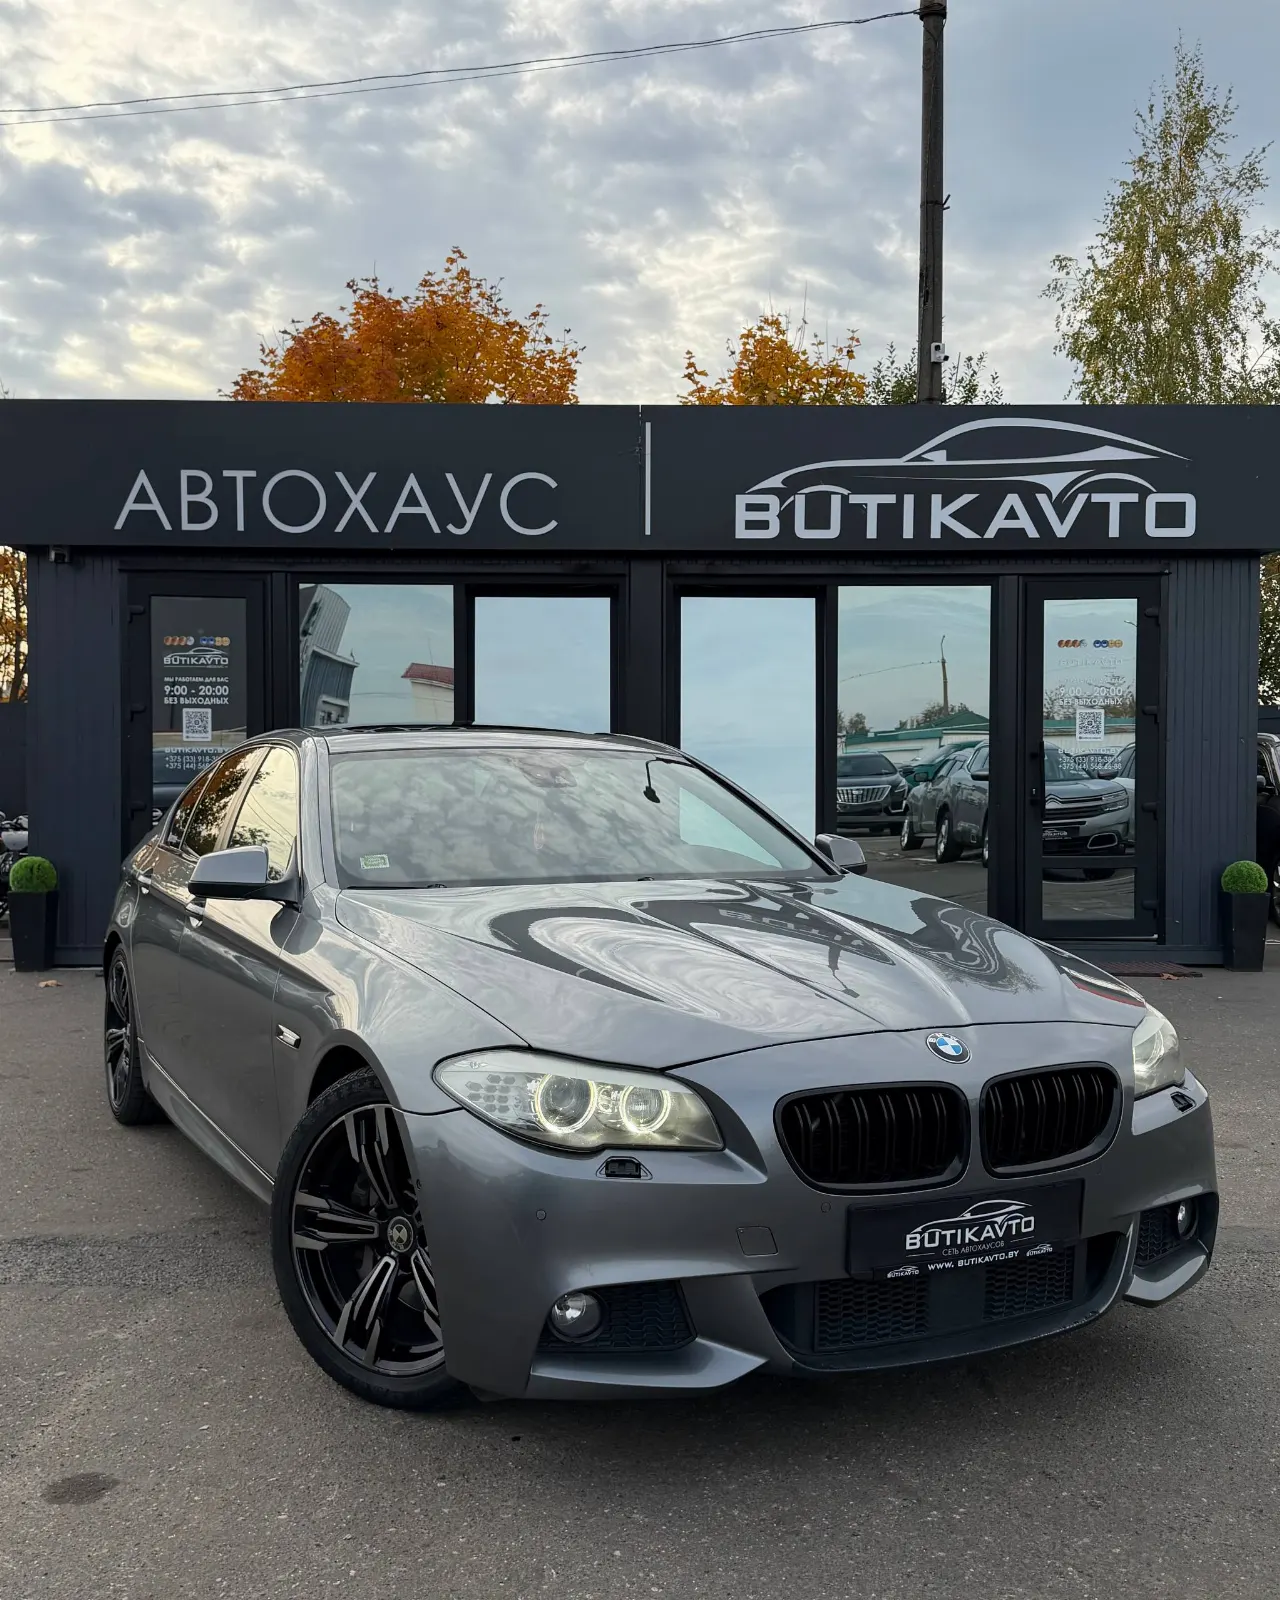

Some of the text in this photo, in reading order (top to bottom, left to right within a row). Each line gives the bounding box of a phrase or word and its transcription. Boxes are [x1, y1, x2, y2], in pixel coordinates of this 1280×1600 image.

[113, 468, 559, 536] АВТОХАУС
[735, 492, 1196, 540] BUTIKAVTO
[163, 656, 229, 665] BUTIKAVTO
[164, 685, 188, 695] 9:00
[198, 685, 229, 696] 20:00
[1093, 686, 1123, 696] 20:00
[163, 696, 229, 706] БЕЗ ВЫХОДНЫХ
[1059, 697, 1123, 706] БЕЗ ВЫХОДНЫХ
[182, 755, 196, 763] (33)
[1075, 756, 1089, 764] (33)
[182, 762, 196, 770] (44)
[1058, 762, 1074, 770] +375
[905, 1215, 1035, 1251] BUTIKAVTO
[957, 1249, 1020, 1267] BUTIKAVTO.BY
